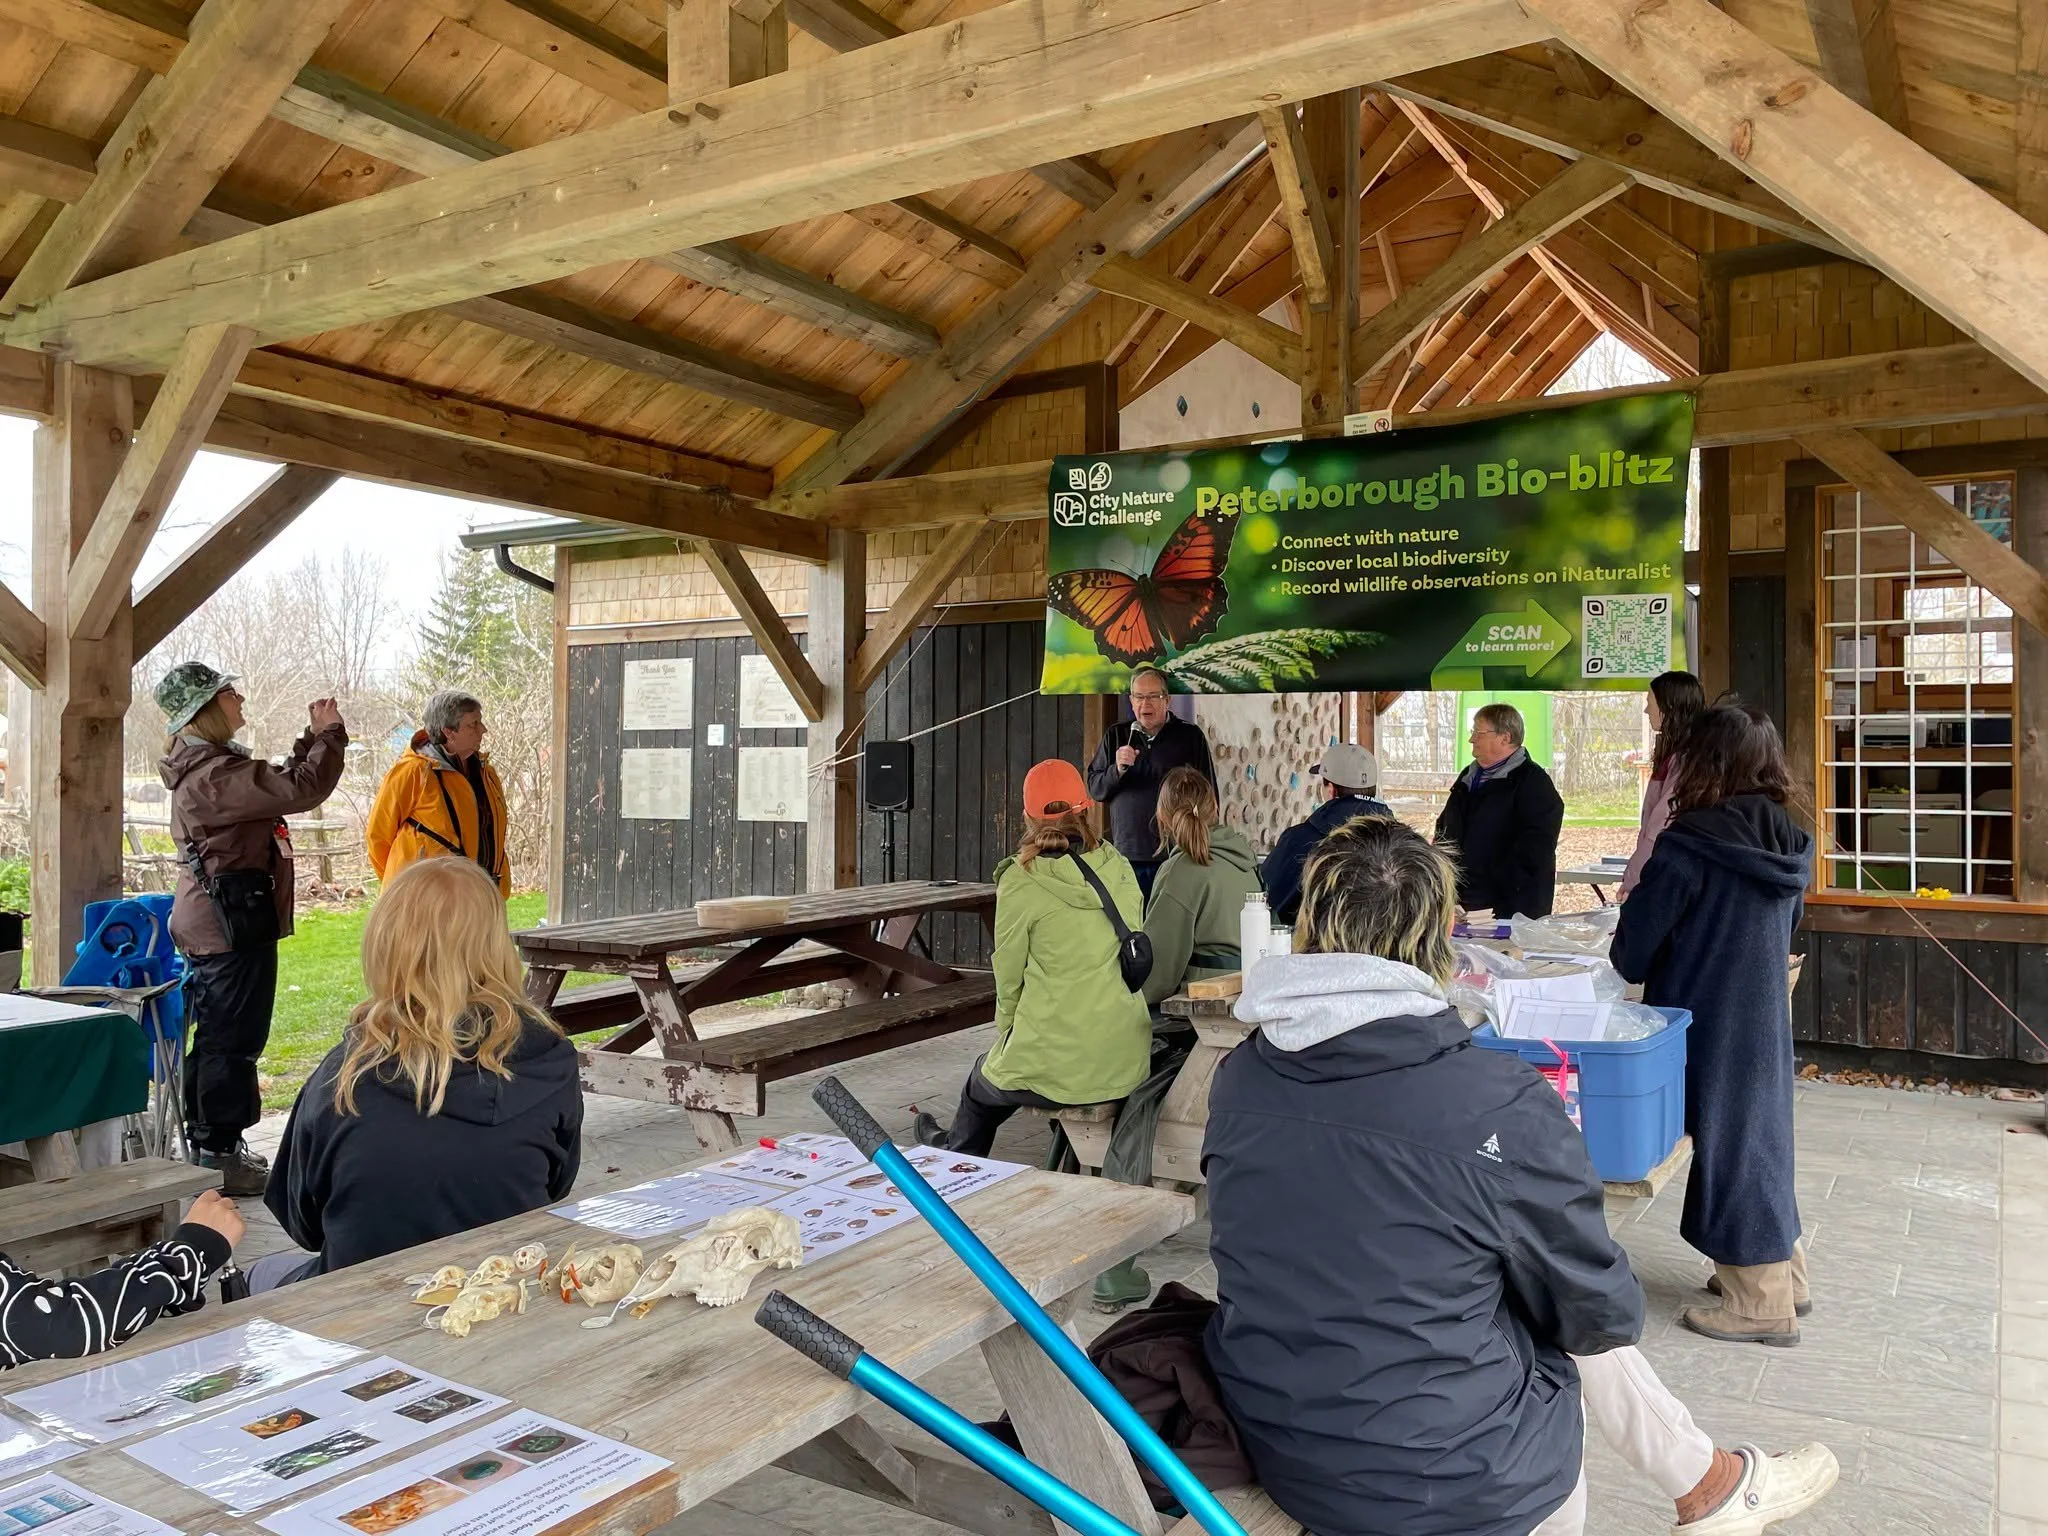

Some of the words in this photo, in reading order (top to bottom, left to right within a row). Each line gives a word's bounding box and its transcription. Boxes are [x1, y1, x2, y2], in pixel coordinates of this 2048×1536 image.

[1196, 464, 1465, 517] Peterborough
[1477, 450, 1674, 497] Bio-blitz
[1089, 494, 1120, 512] City
[1122, 490, 1174, 507] Nature
[1088, 508, 1162, 526] Challenge
[1281, 533, 1351, 550] Connect
[1355, 529, 1394, 546] with
[1398, 528, 1459, 543] nature
[1281, 558, 1353, 573] Discover
[1356, 552, 1398, 570] local
[1402, 547, 1510, 567] biodiversity
[1280, 578, 1340, 596] Record
[1344, 576, 1408, 594] wildlife
[1411, 569, 1529, 590] observations
[1533, 571, 1557, 584] on
[1562, 563, 1672, 583] iNaturalist
[1488, 624, 1542, 641] SCAN
[1620, 634, 1632, 643] ME
[1465, 642, 1479, 652] to
[1480, 641, 1513, 652] learn
[1516, 640, 1554, 652] more!
[1476, 1149, 1503, 1163] WOODS
[515, 1509, 537, 1520] food
